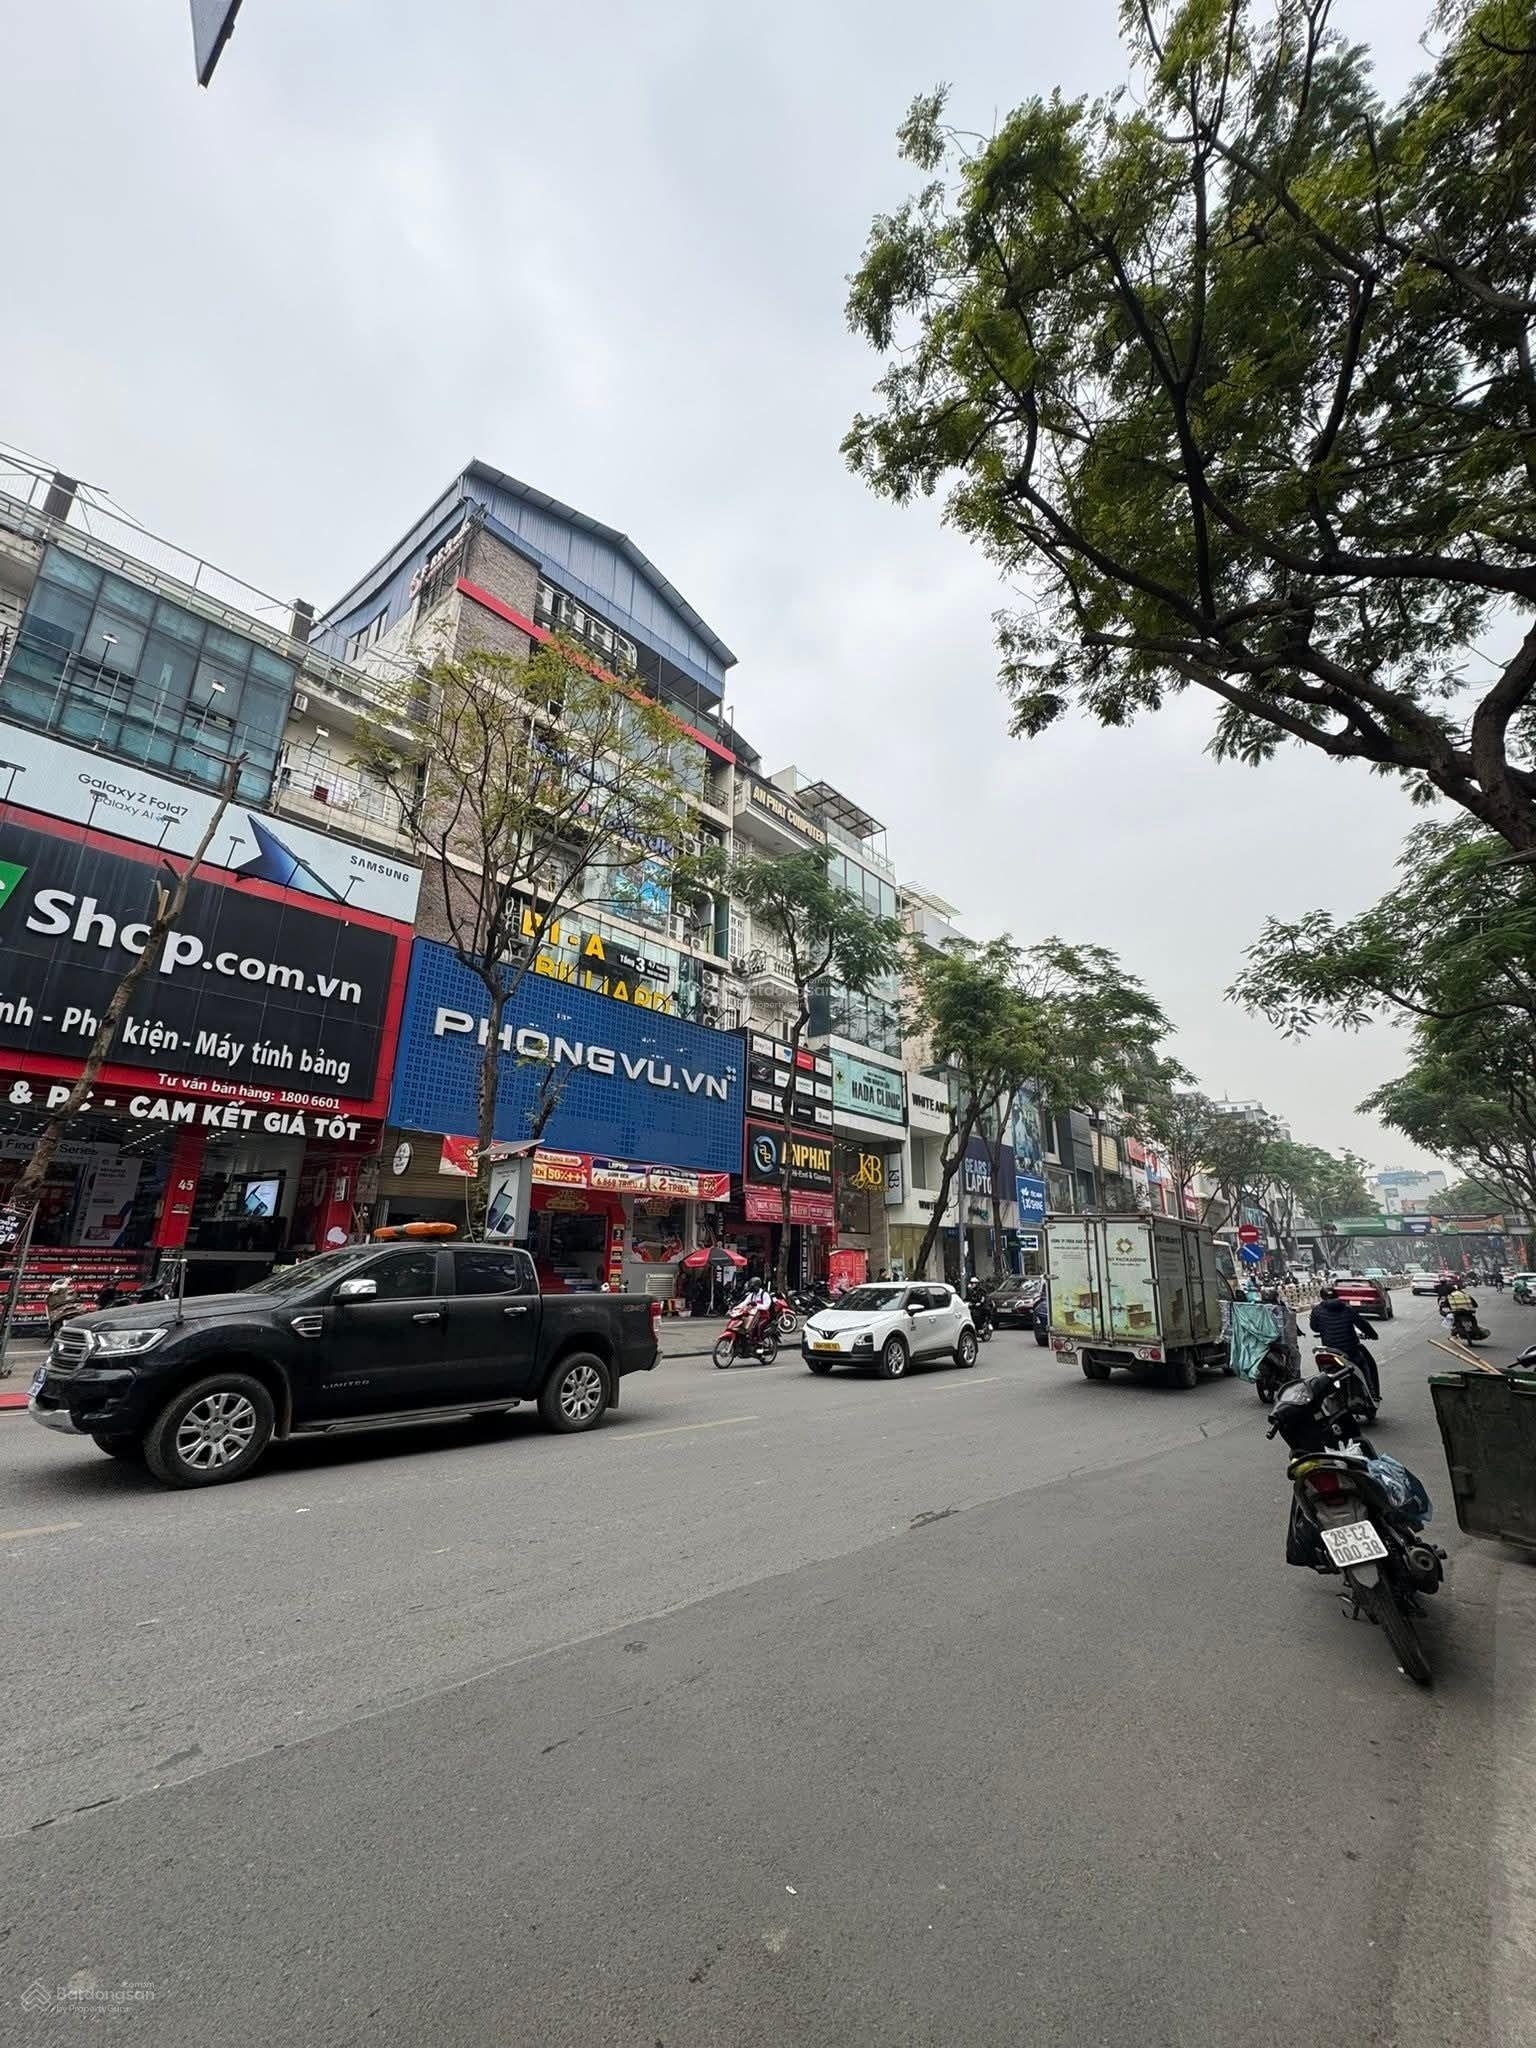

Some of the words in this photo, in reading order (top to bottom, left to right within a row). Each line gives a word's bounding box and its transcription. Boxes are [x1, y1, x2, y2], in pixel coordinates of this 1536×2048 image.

[78, 773, 137, 801] Galaxy
[137, 792, 147, 803] Z
[149, 796, 189, 817] Fold7
[142, 809, 154, 820] AI
[349, 854, 411, 882] SAMSUNG
[635, 957, 646, 973] 3
[61, 1007, 103, 1037] Ph
[122, 1016, 179, 1054] kiện
[194, 1030, 245, 1066] Máy
[251, 1038, 293, 1069] tính
[299, 1048, 351, 1083] bảng
[158, 1073, 178, 1087] Tư
[182, 1076, 207, 1091] vấn
[211, 1080, 236, 1096] bán
[238, 1084, 275, 1103] hàng:
[279, 1091, 309, 1105] 1800
[310, 1095, 341, 1110] 6601
[851, 1080, 874, 1104] HADA
[911, 1092, 934, 1111] WHITE
[935, 1100, 947, 1114] AN
[9, 1080, 33, 1105] &
[129, 1095, 197, 1123] CAM
[201, 1100, 258, 1130] KẾT
[263, 1109, 306, 1137] GIÁ
[314, 1113, 361, 1141] TỐT
[177, 1179, 194, 1192] 45
[965, 1172, 992, 1195] LAPTO
